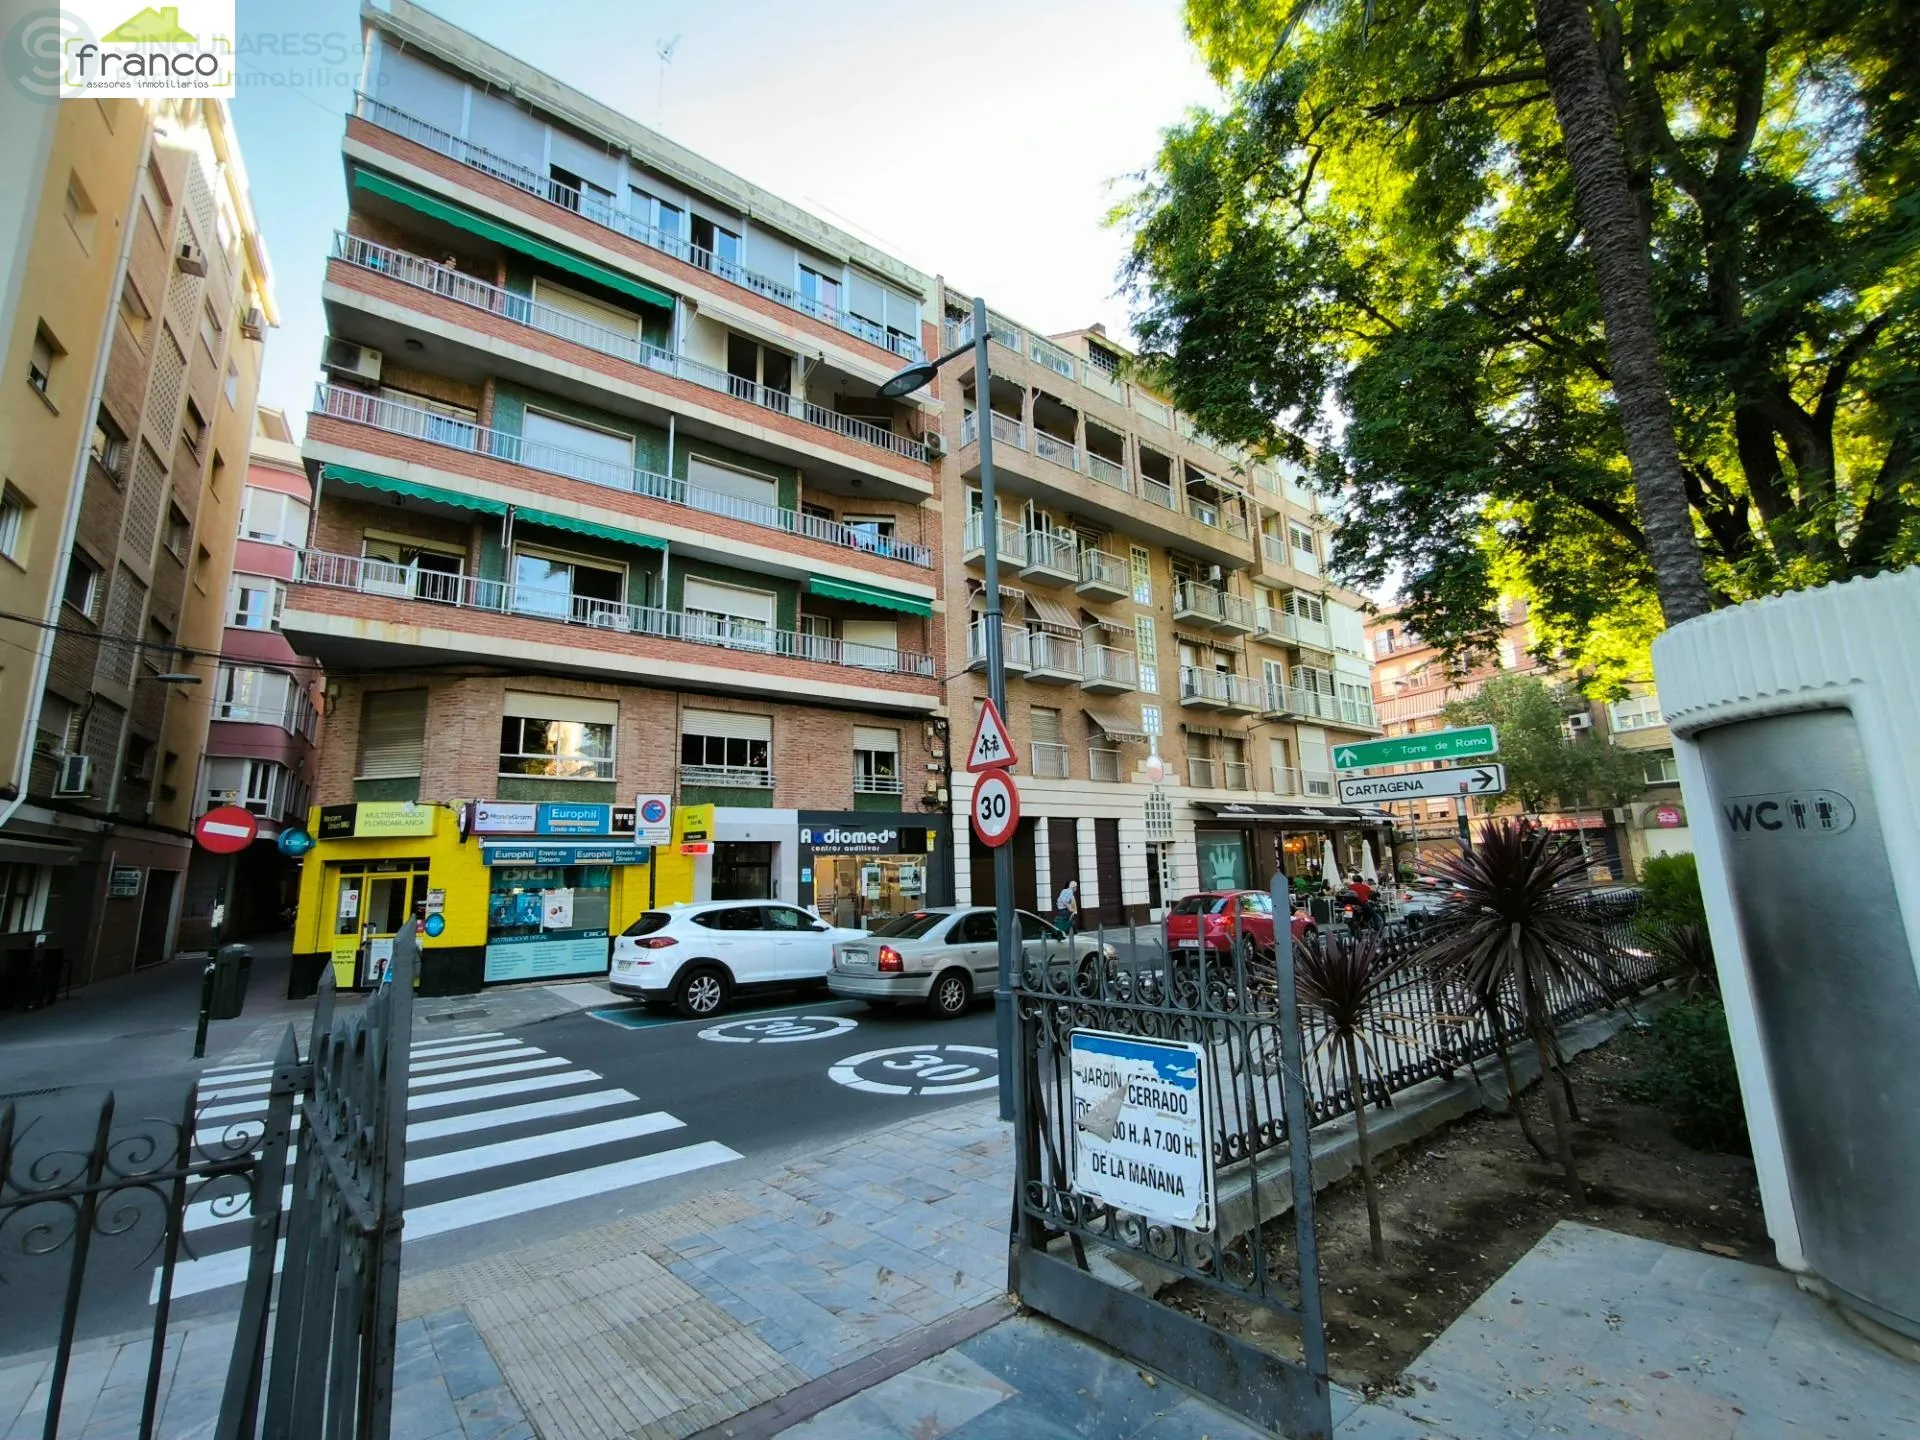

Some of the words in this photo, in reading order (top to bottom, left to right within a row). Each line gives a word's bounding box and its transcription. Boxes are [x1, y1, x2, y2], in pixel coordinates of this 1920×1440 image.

[1401, 744, 1427, 755] Torre
[1435, 740, 1448, 750] de
[1455, 737, 1488, 748] Romo
[1345, 779, 1424, 797] CARTAGENA
[551, 808, 598, 820] Europhil
[980, 793, 1006, 821] 30
[1723, 801, 1783, 831] WC
[494, 850, 534, 859] Europhil
[576, 850, 612, 860] Europhil
[583, 930, 607, 938] DIGI
[744, 1021, 817, 1036] 30
[882, 1054, 980, 1081] 30
[1082, 1064, 1122, 1089] JARDÍN
[1128, 1084, 1188, 1115] CERRADO
[1129, 1123, 1140, 1144] H.
[1143, 1126, 1152, 1147] A
[1154, 1130, 1181, 1155] 7.00
[1185, 1136, 1198, 1159] H.
[1092, 1153, 1107, 1175] DE
[1110, 1157, 1126, 1180] LA
[1129, 1162, 1186, 1198] MAÑANA
